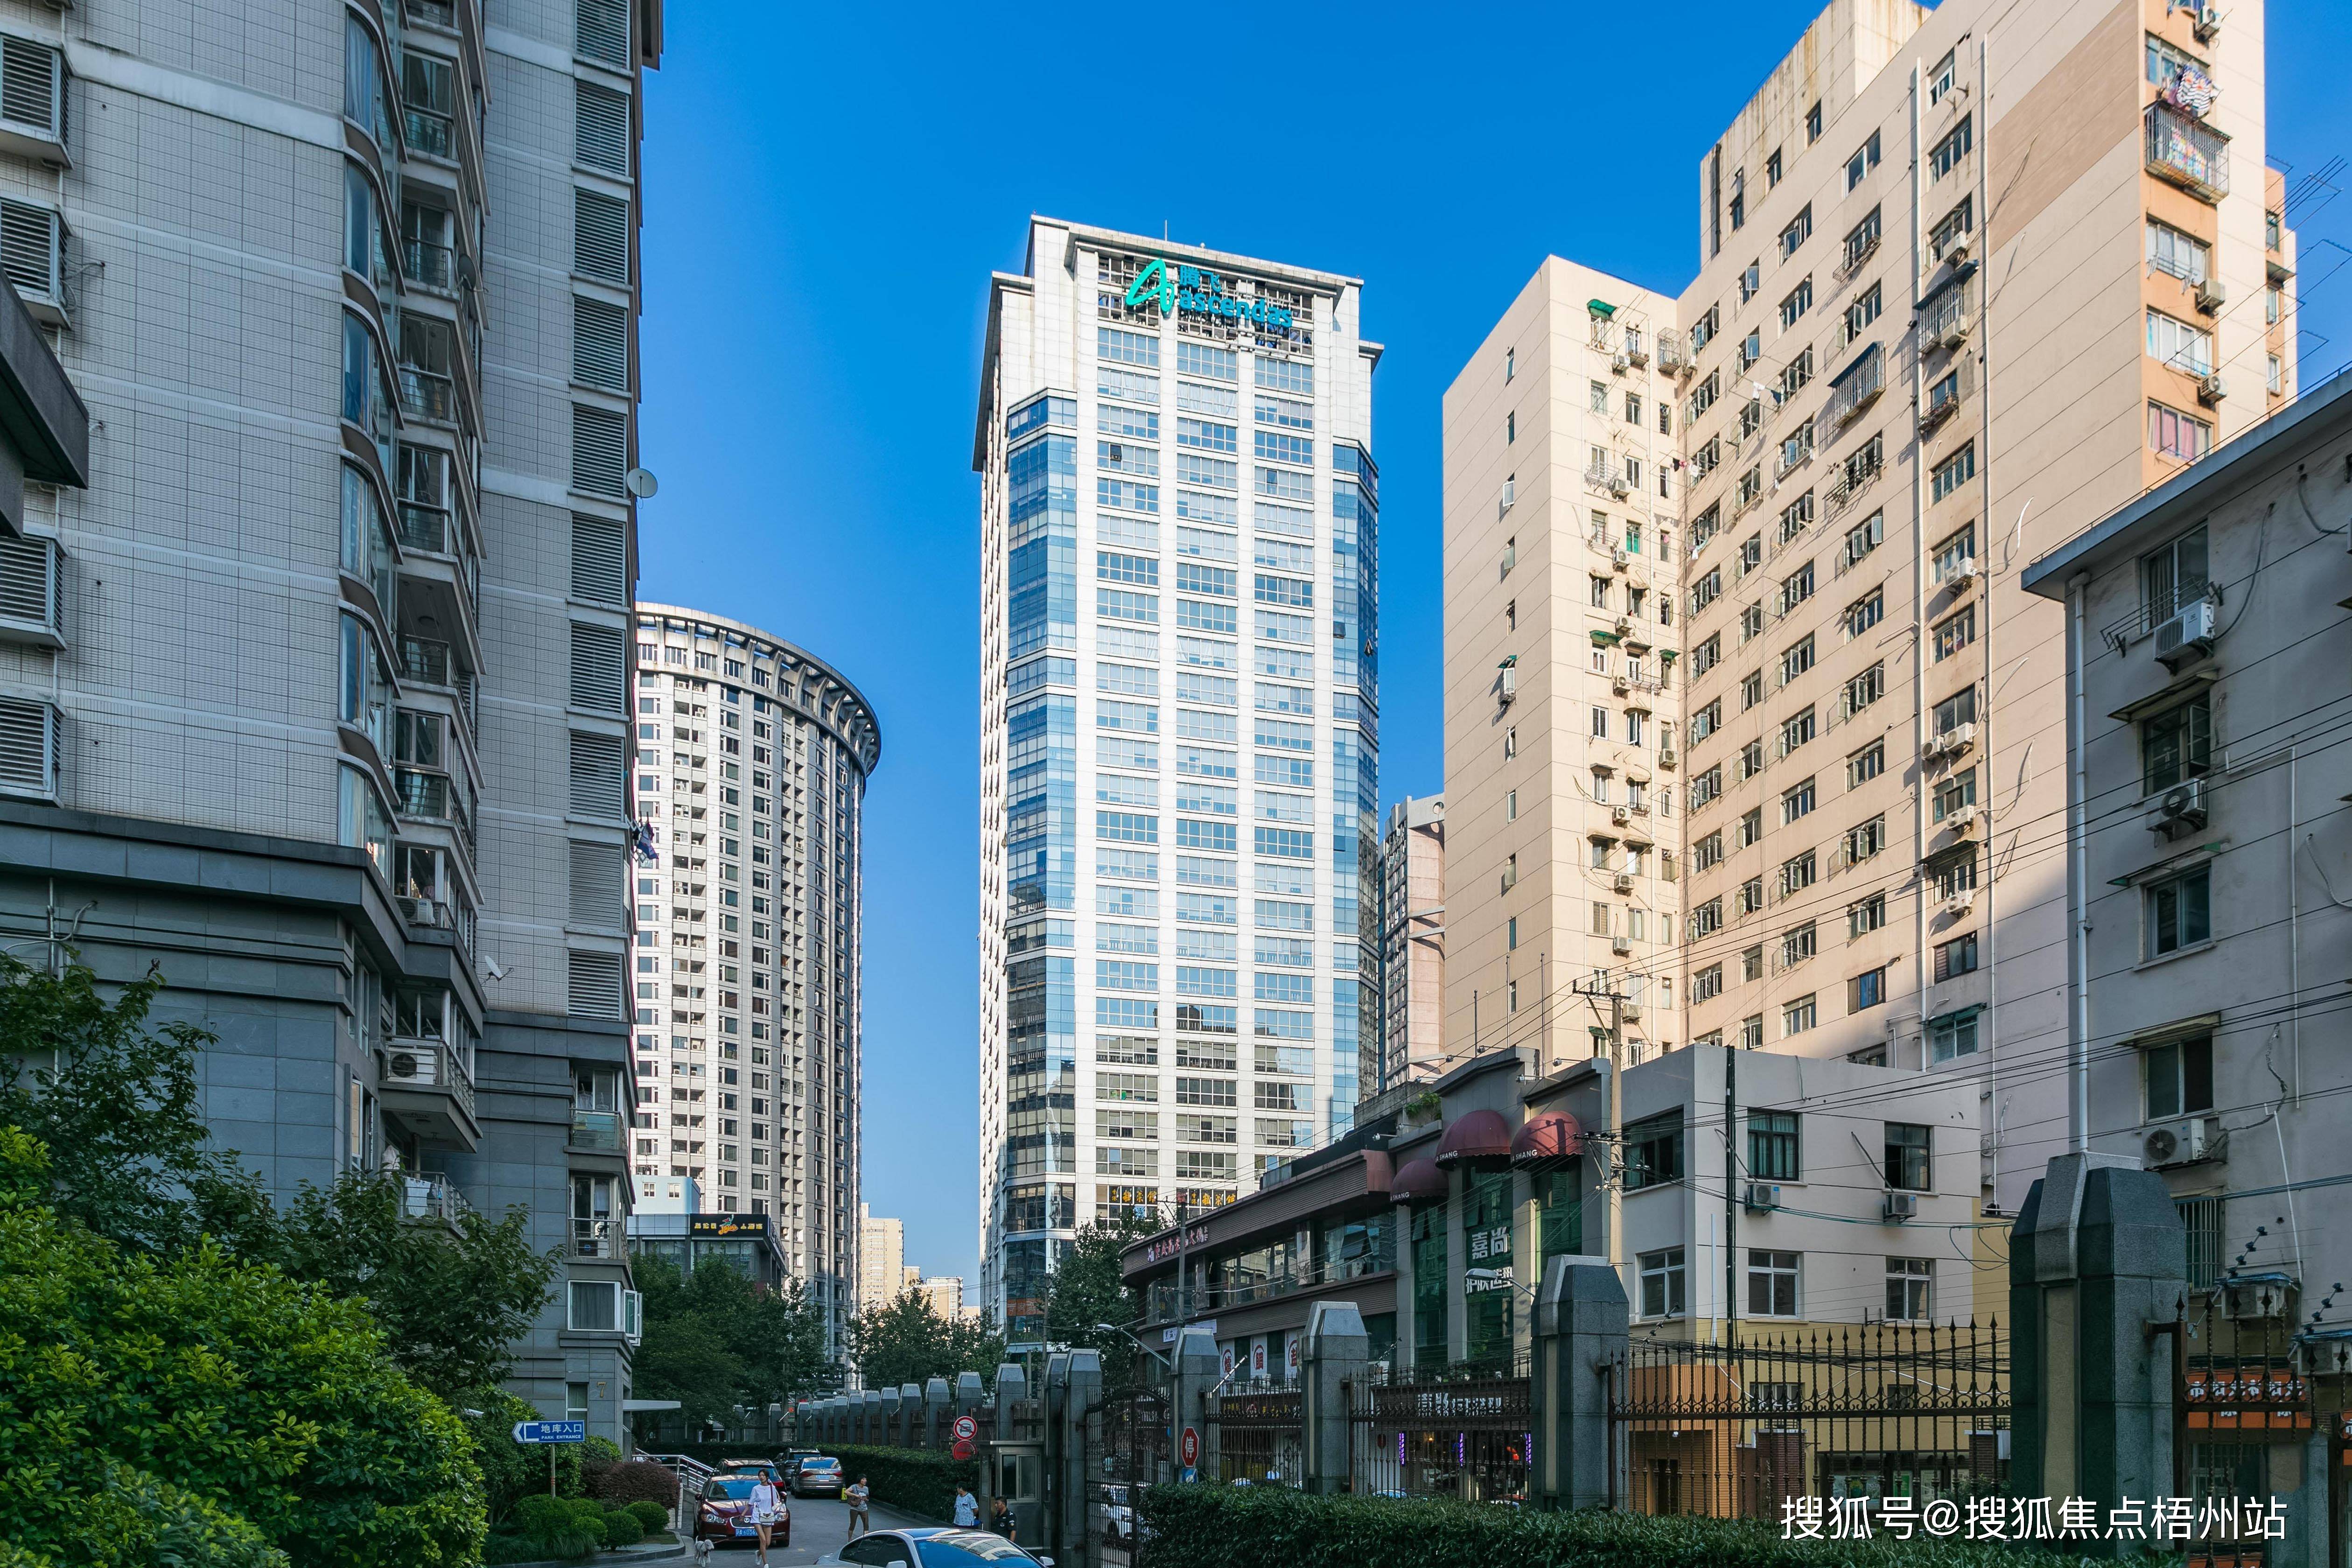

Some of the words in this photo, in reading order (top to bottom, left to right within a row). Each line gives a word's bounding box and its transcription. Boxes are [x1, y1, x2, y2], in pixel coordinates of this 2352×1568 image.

[1180, 265, 1222, 293] 腾飞
[1179, 289, 1293, 328] ascendas
[1439, 1150, 1458, 1161] SHANG
[1516, 1149, 1538, 1160] SHANG
[1393, 1191, 1410, 1201] SHANG
[1472, 1226, 1509, 1260] 嘉尚
[597, 1382, 606, 1398] 7
[541, 1424, 582, 1433] 地库入口
[1185, 1436, 1194, 1458] 停
